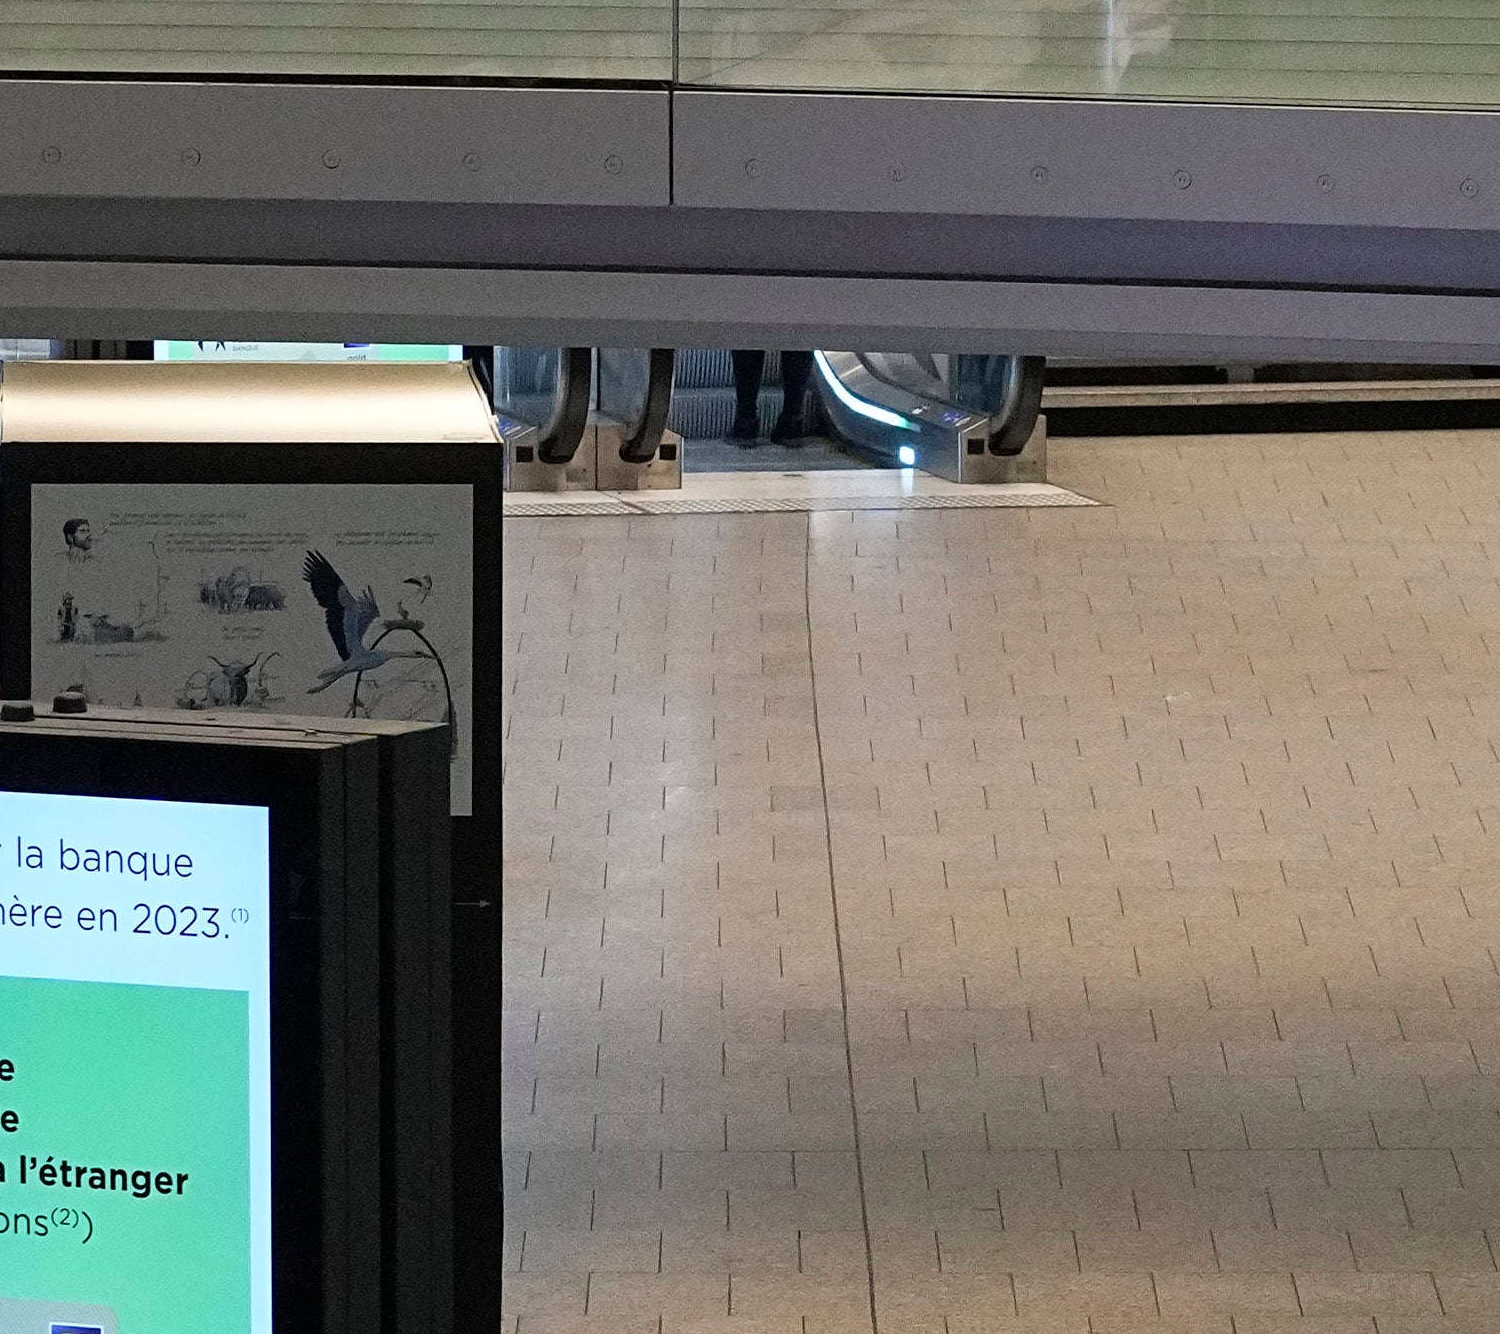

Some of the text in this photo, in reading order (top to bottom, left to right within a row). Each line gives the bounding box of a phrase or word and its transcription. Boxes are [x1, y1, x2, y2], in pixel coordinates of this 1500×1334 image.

[16, 837, 45, 870] la
[59, 838, 195, 883] banque
[76, 904, 119, 934] en
